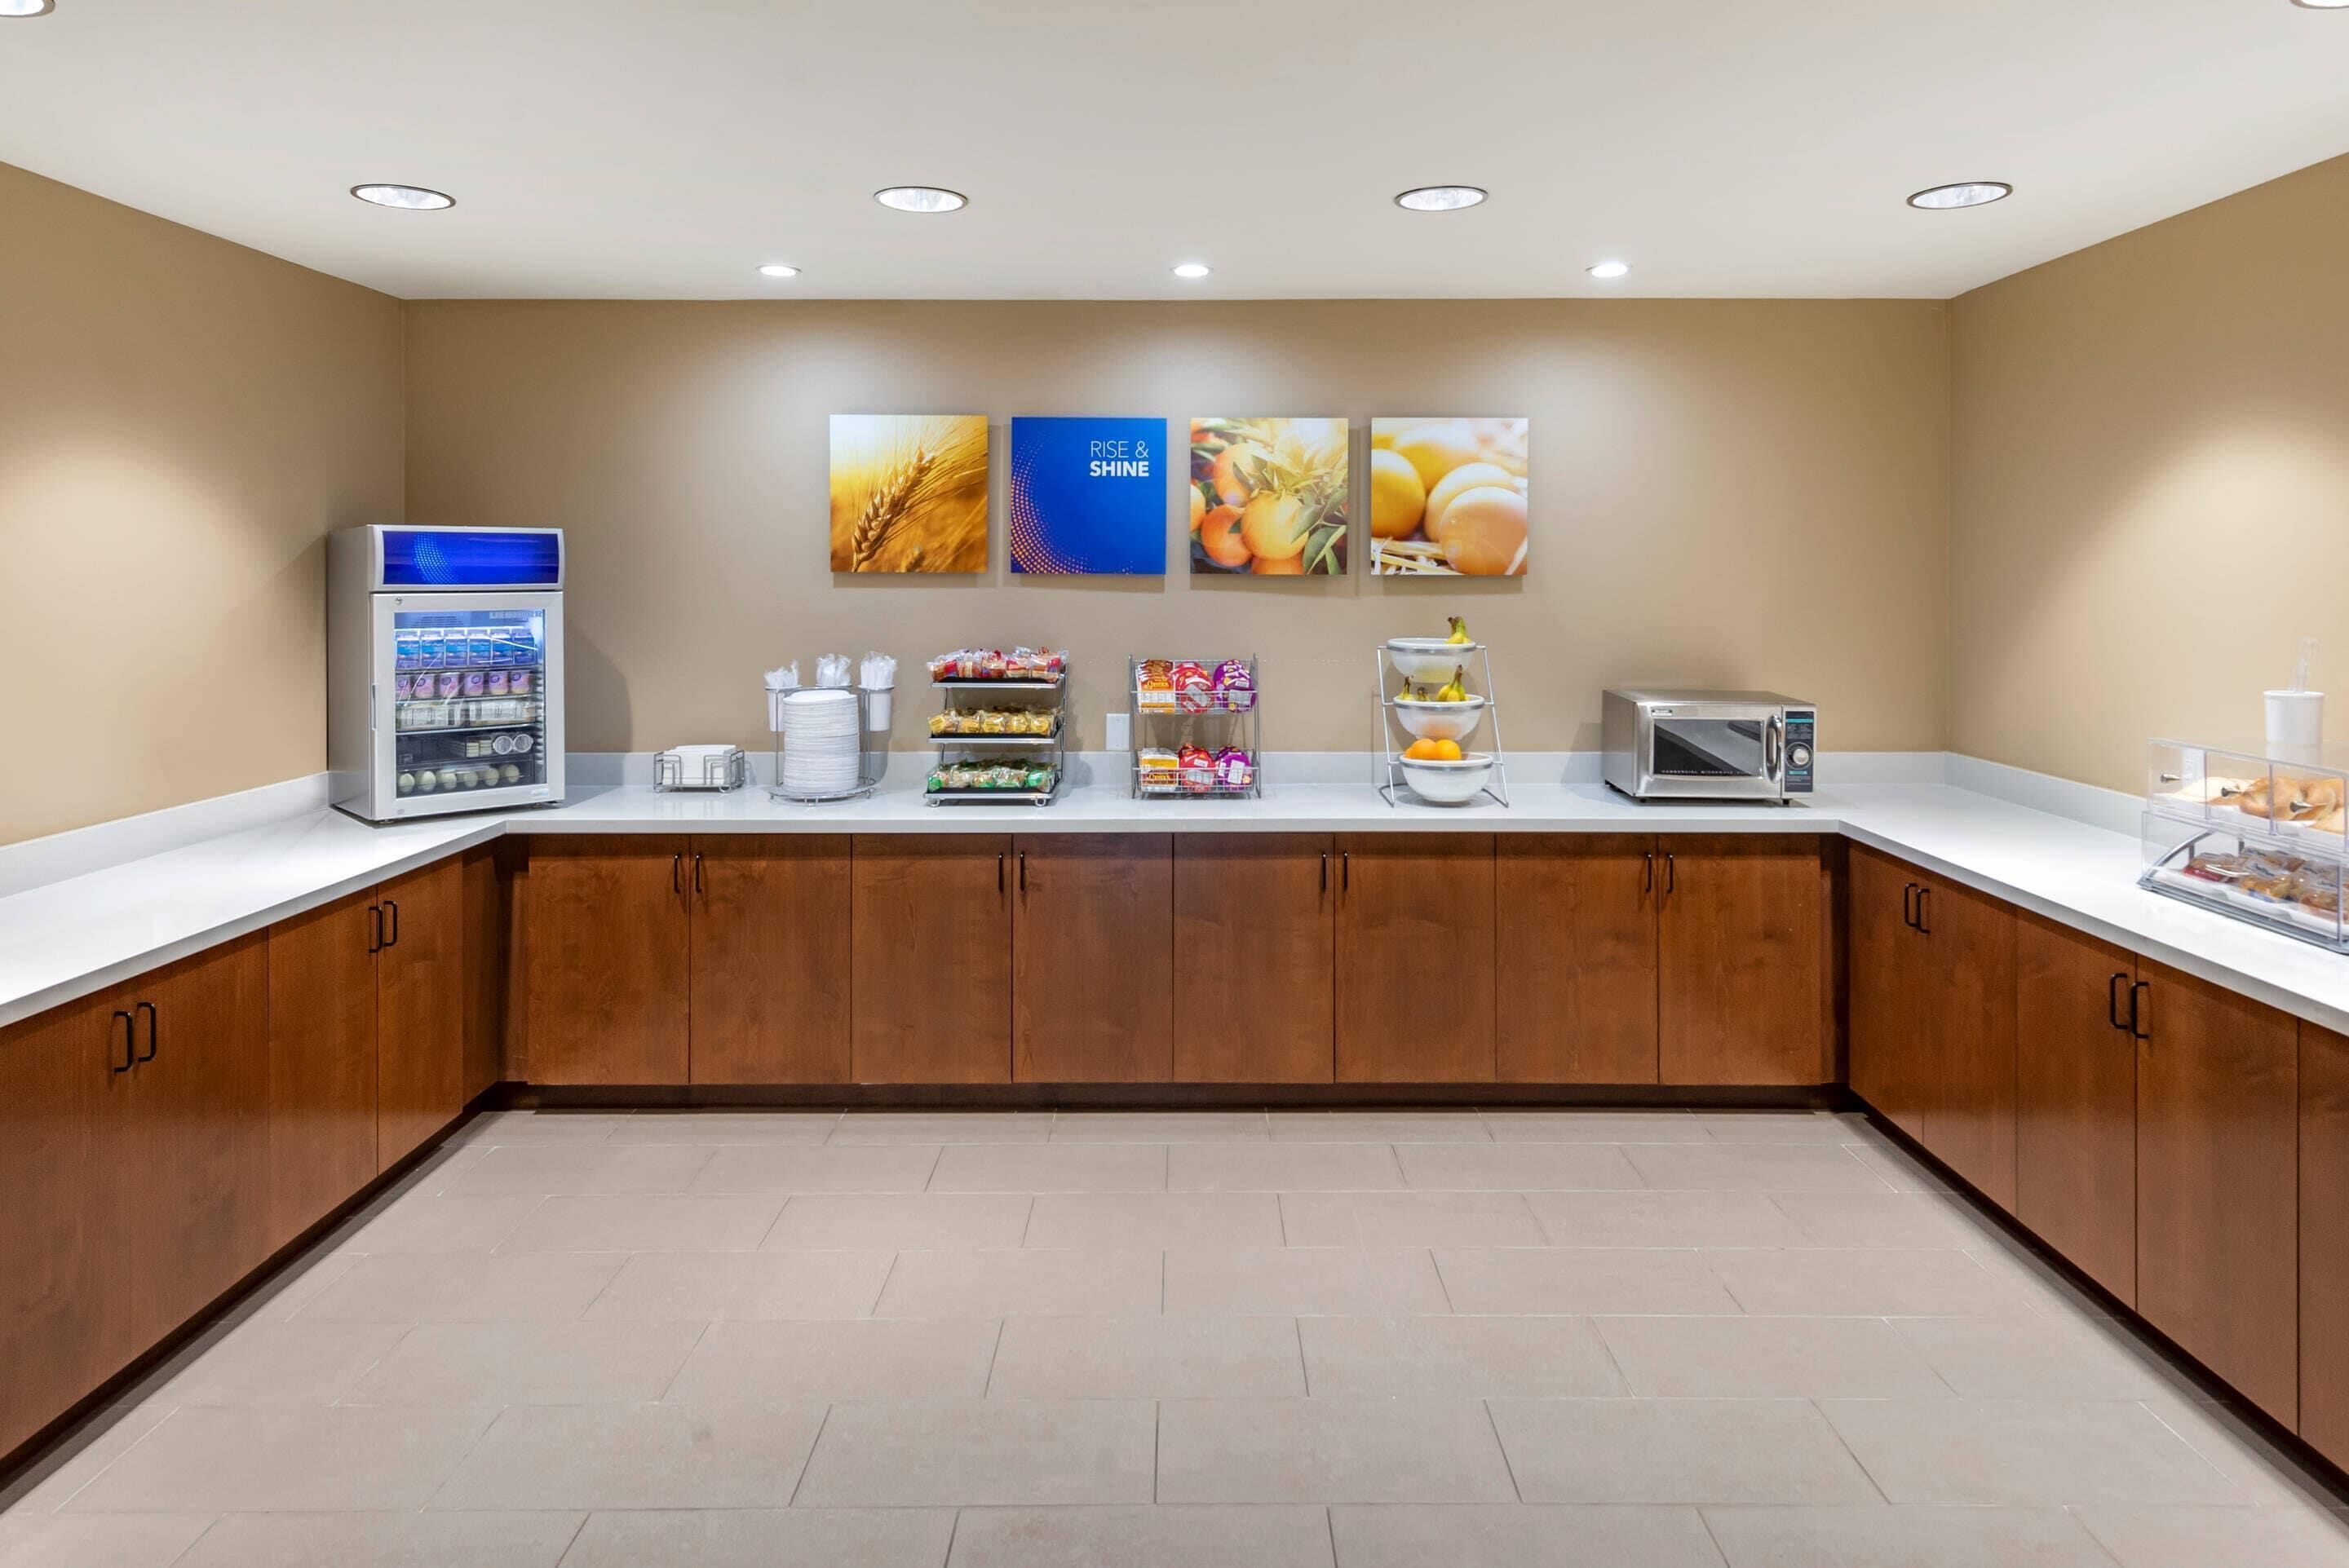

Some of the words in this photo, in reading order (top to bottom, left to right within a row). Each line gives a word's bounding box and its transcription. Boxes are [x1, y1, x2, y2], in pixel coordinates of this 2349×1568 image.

[1090, 440, 1129, 457] RISE
[1135, 440, 1148, 457] &
[1090, 461, 1149, 476] SHINE
